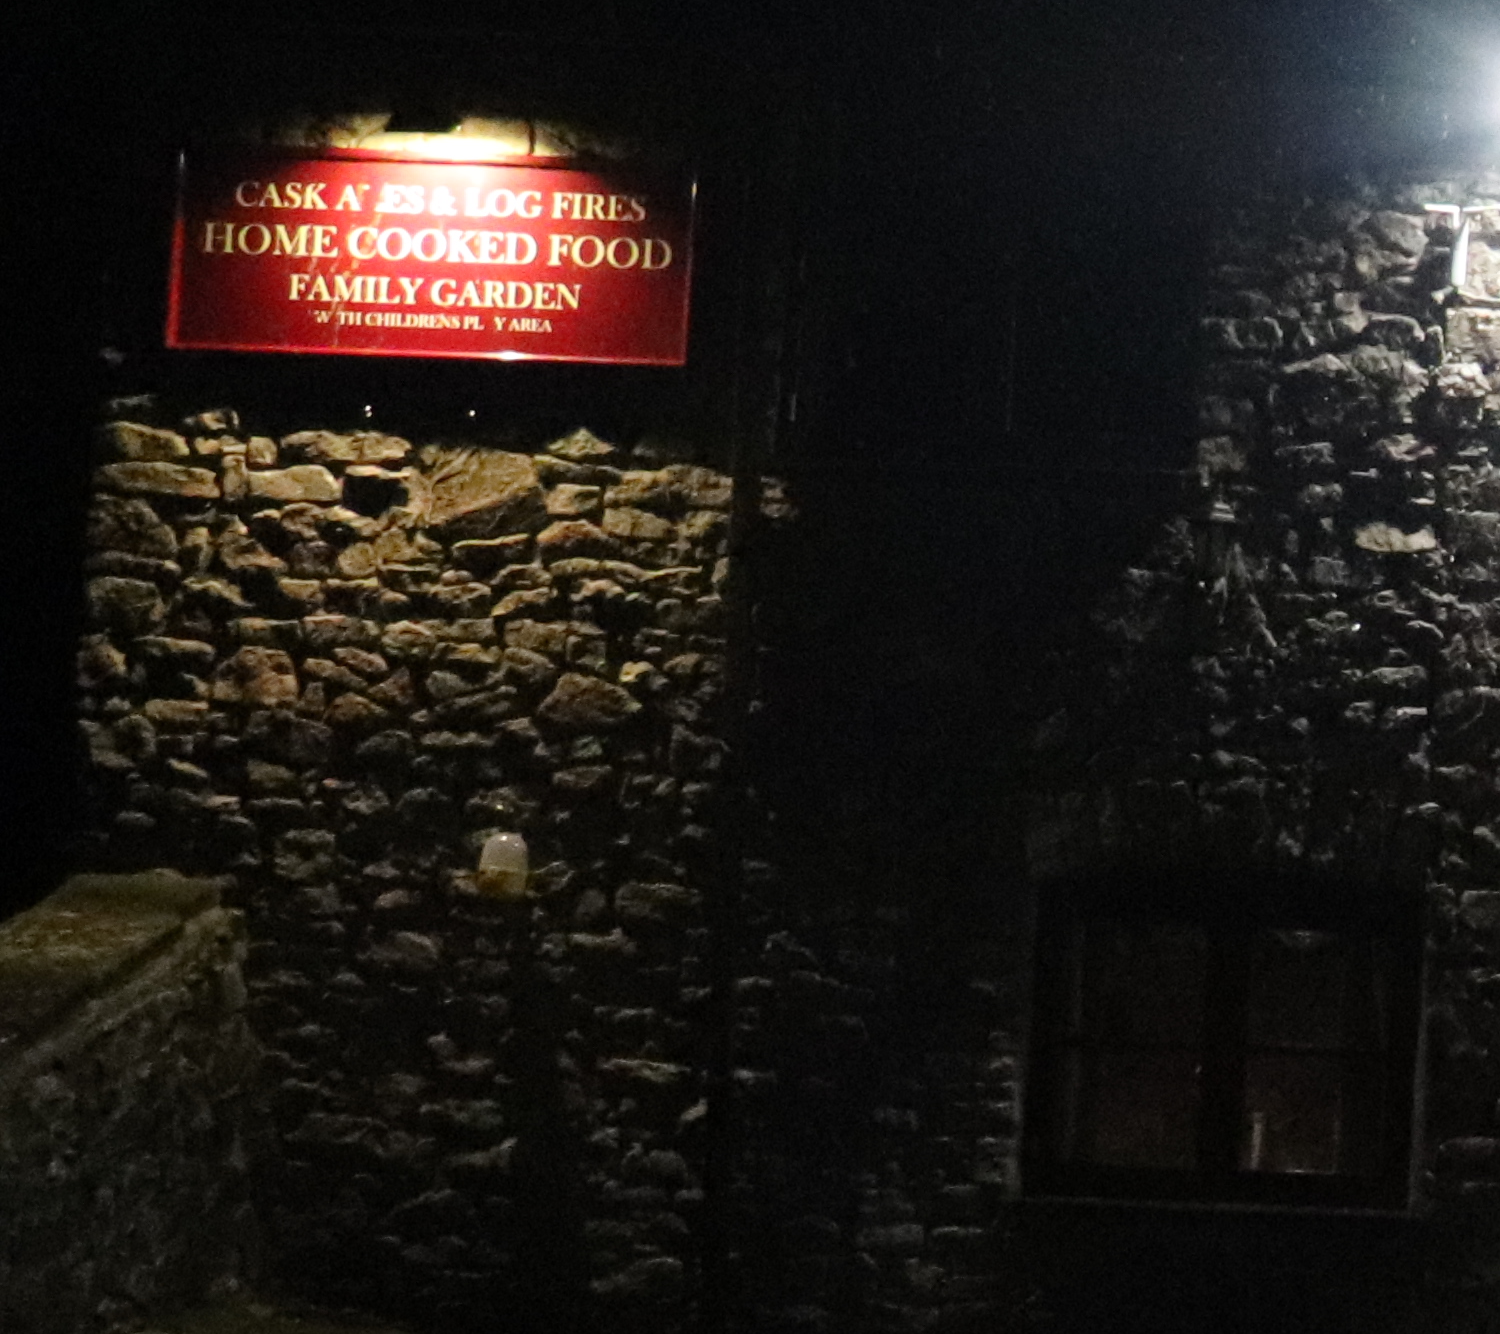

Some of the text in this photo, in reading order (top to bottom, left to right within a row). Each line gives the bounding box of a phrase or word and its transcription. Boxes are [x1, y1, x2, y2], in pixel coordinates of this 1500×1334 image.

[235, 180, 647, 223] CASK AES & LOG FIRES
[203, 221, 674, 271] HOME COOKED FOOD
[288, 272, 583, 311] FAMILY GARDEN
[311, 309, 553, 334] WTH CHILDRENS PLY AREA
